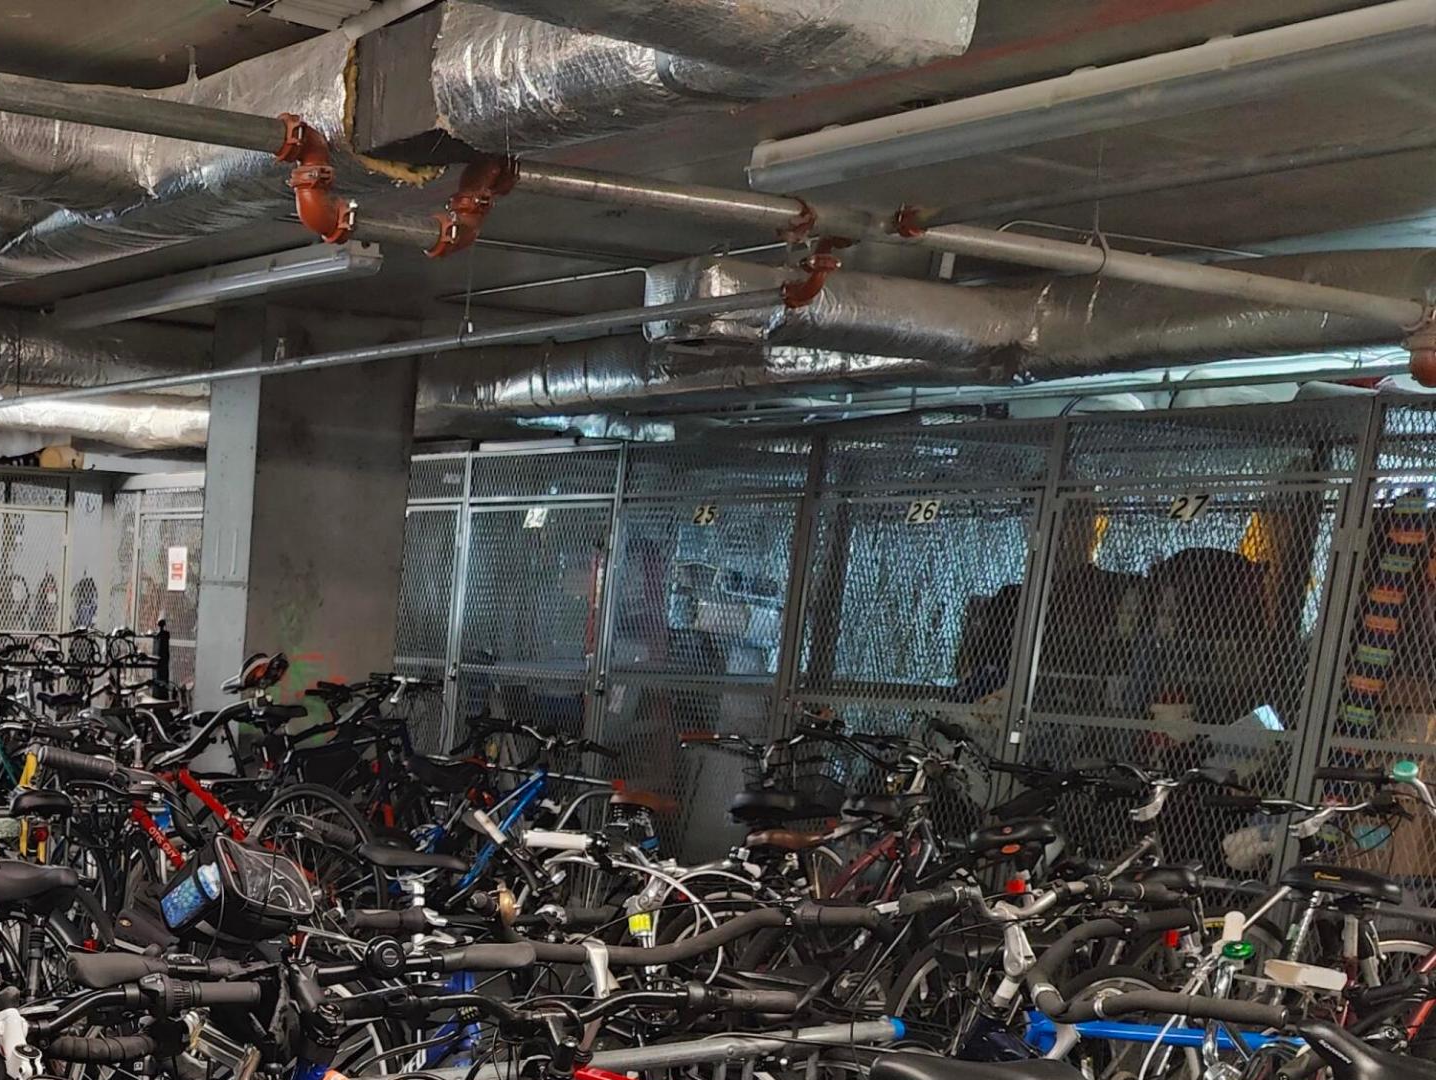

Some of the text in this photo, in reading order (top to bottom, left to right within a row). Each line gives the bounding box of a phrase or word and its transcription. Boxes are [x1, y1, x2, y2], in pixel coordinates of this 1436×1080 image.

[694, 506, 716, 524] 25
[908, 502, 934, 522] 26
[1171, 494, 1209, 520] 27
[148, 826, 181, 858] OTIS GUY
